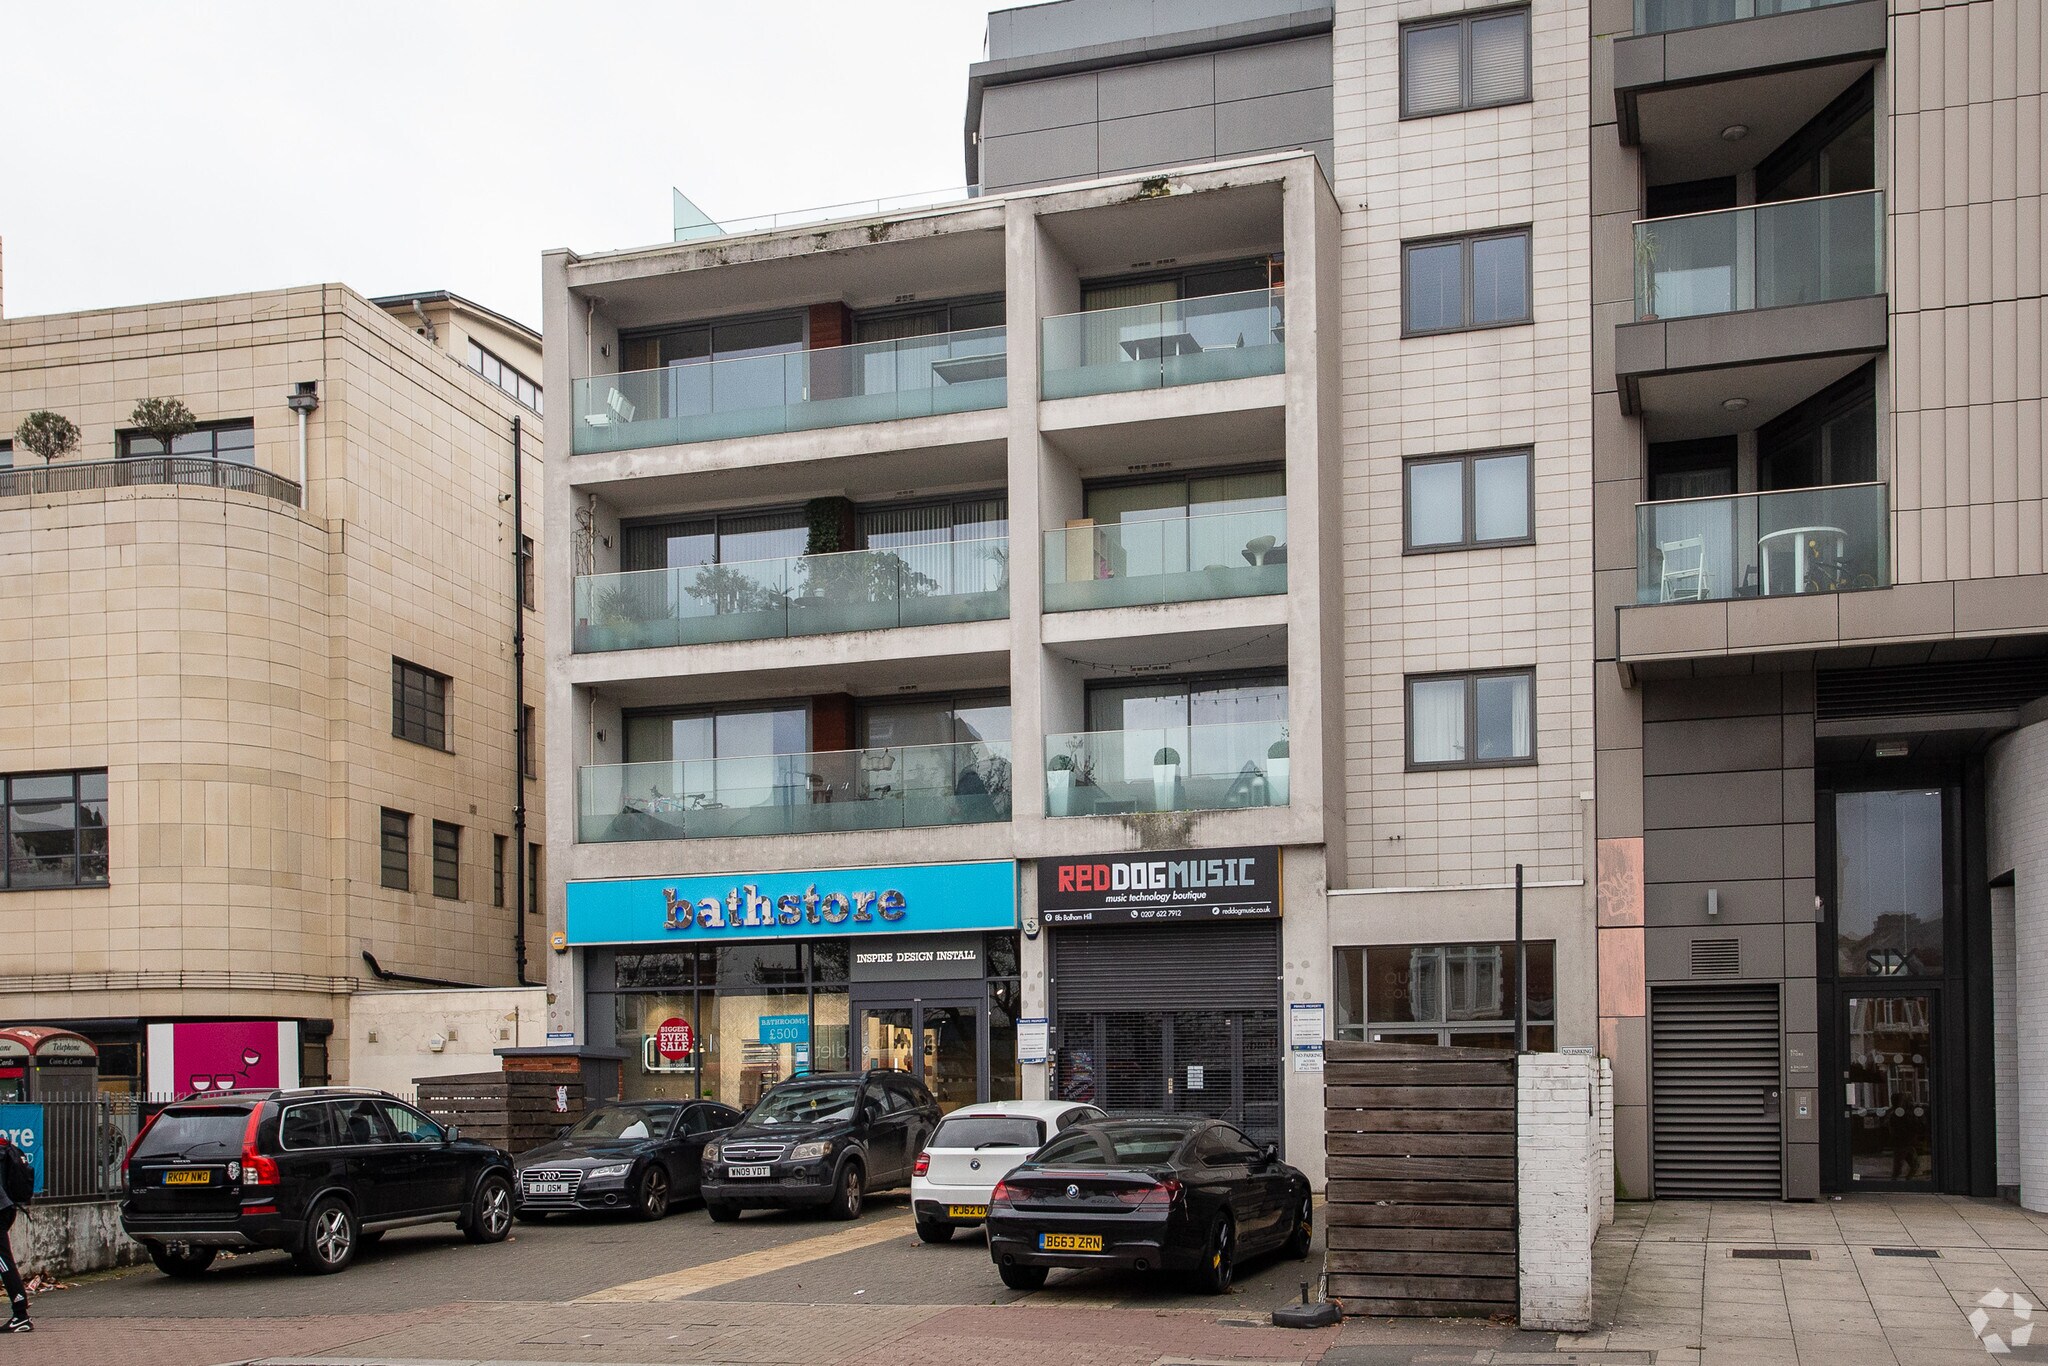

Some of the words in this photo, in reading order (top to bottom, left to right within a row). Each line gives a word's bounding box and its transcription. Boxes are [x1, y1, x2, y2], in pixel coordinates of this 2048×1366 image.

[1105, 894, 1127, 903] music
[1128, 892, 1170, 904] technology
[1172, 890, 1207, 902] boutique
[662, 884, 907, 930] bathstore
[1140, 910, 1155, 918] 0207
[1168, 909, 1182, 917] 7912
[856, 953, 893, 963] INSPIRE
[896, 952, 933, 962] DESIGN
[936, 950, 977, 960] INSTALL
[1866, 948, 1919, 976] SIX
[761, 1018, 806, 1026] BATHROOMS
[660, 1032, 689, 1042] EVER
[769, 1028, 798, 1040] £500
[53, 1042, 80, 1053] Telephone
[660, 1041, 689, 1052] SALE
[168, 1172, 190, 1182] RK07
[731, 1168, 750, 1176] WN09
[752, 1167, 766, 1175] VDT
[953, 1205, 975, 1214] RJ62
[1046, 1236, 1075, 1248] BG63
[1078, 1237, 1100, 1249] ZRN
